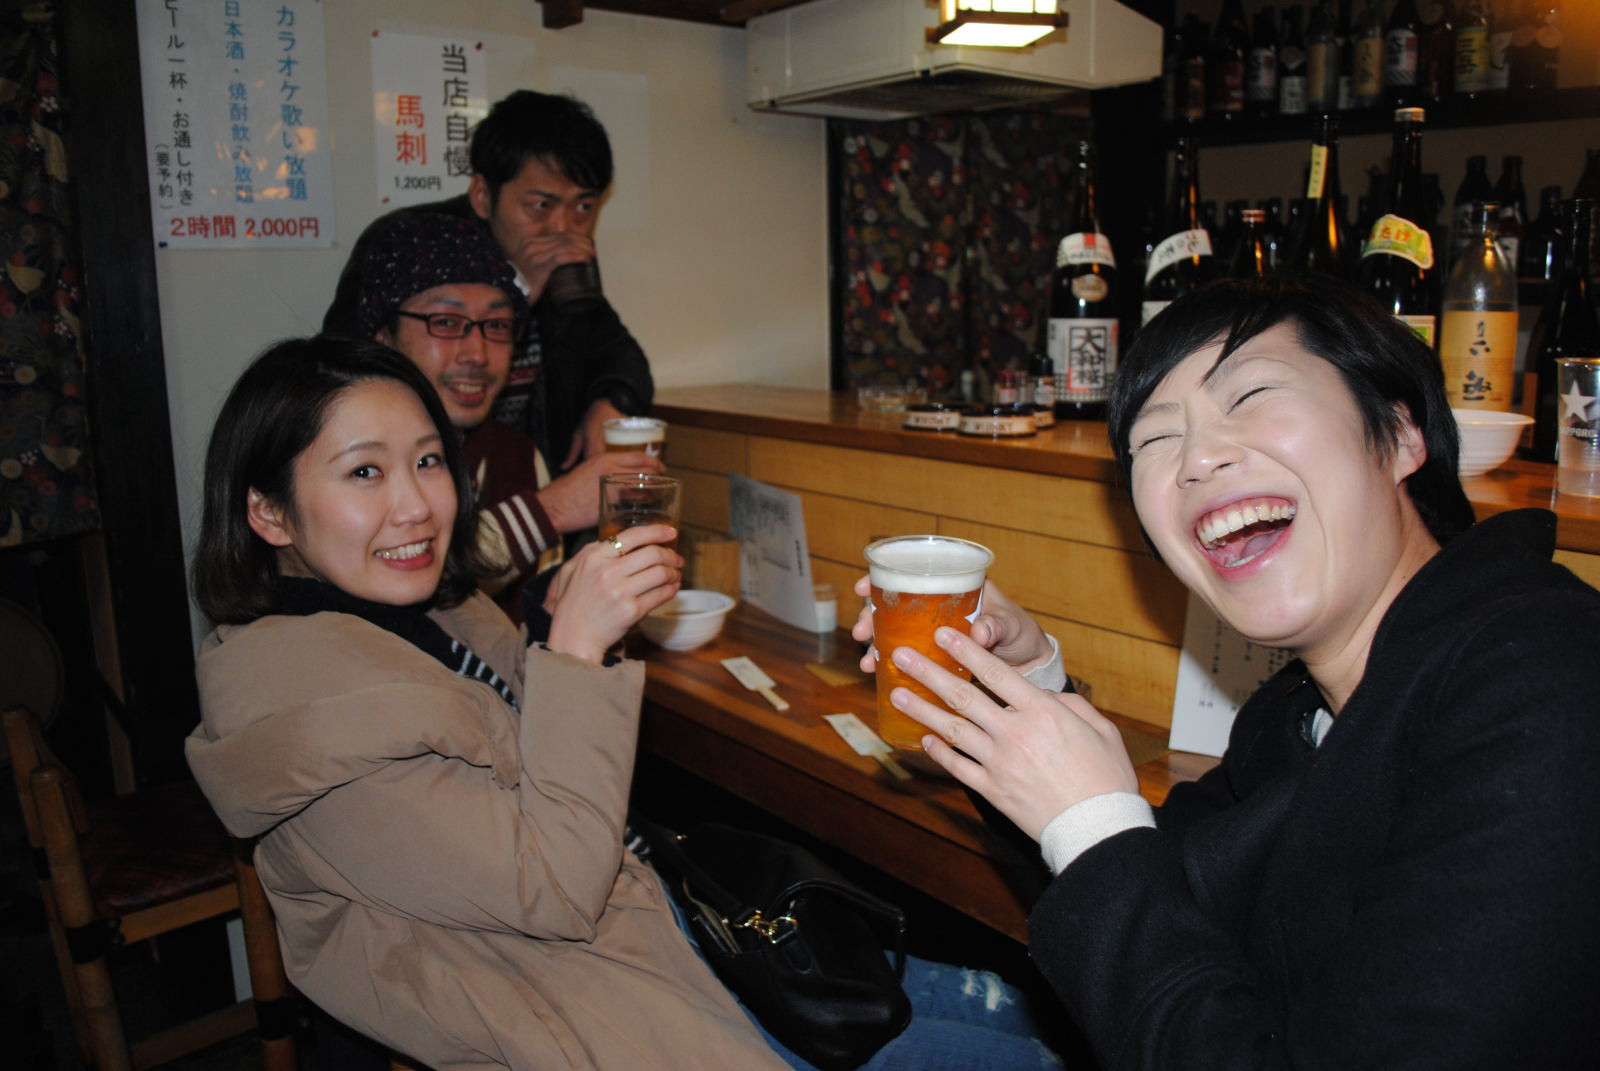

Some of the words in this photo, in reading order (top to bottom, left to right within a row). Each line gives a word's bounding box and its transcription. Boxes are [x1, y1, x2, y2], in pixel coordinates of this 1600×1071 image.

[395, 94, 427, 165] 馬刺
[441, 43, 473, 177] 当店自慢
[394, 176, 441, 190] 1,200円
[170, 216, 236, 238] 2時間
[244, 217, 320, 238] 2,000円
